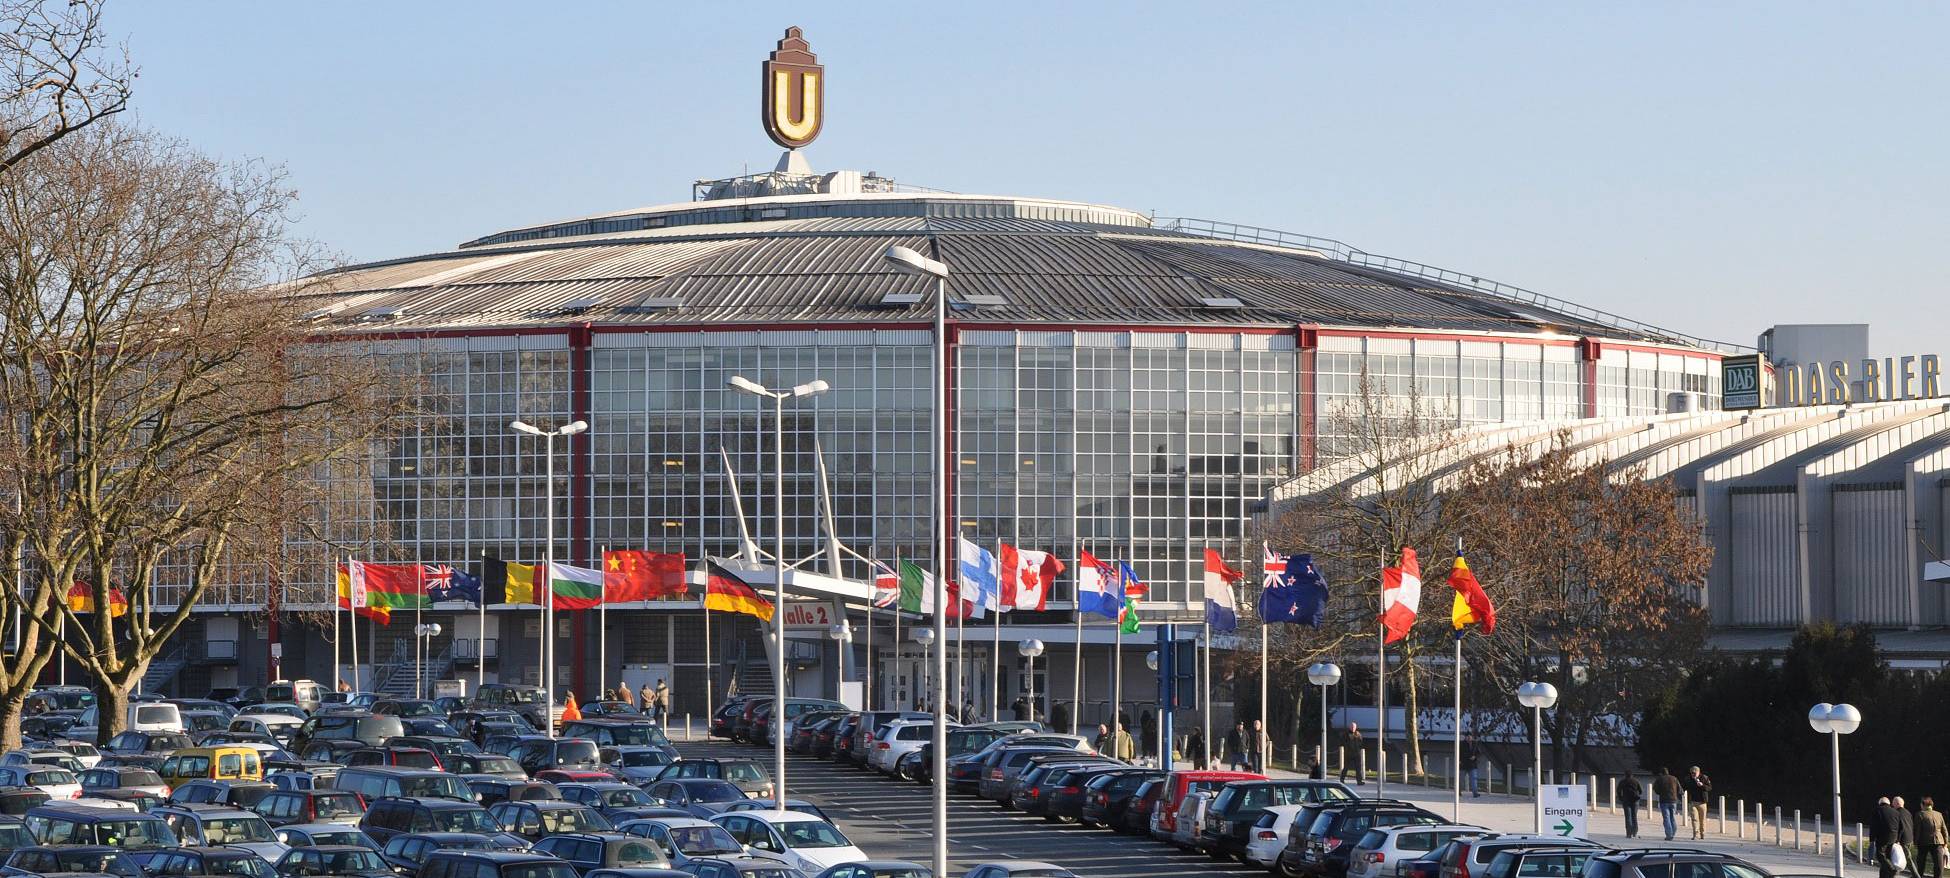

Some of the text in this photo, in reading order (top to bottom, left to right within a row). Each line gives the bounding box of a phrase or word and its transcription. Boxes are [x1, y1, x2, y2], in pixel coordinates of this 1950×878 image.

[773, 70, 819, 141] U
[1727, 367, 1755, 391] DAB
[1783, 354, 1942, 408] DAS BIER
[783, 605, 828, 625] alle 2
[1544, 807, 1583, 817] Eingang
